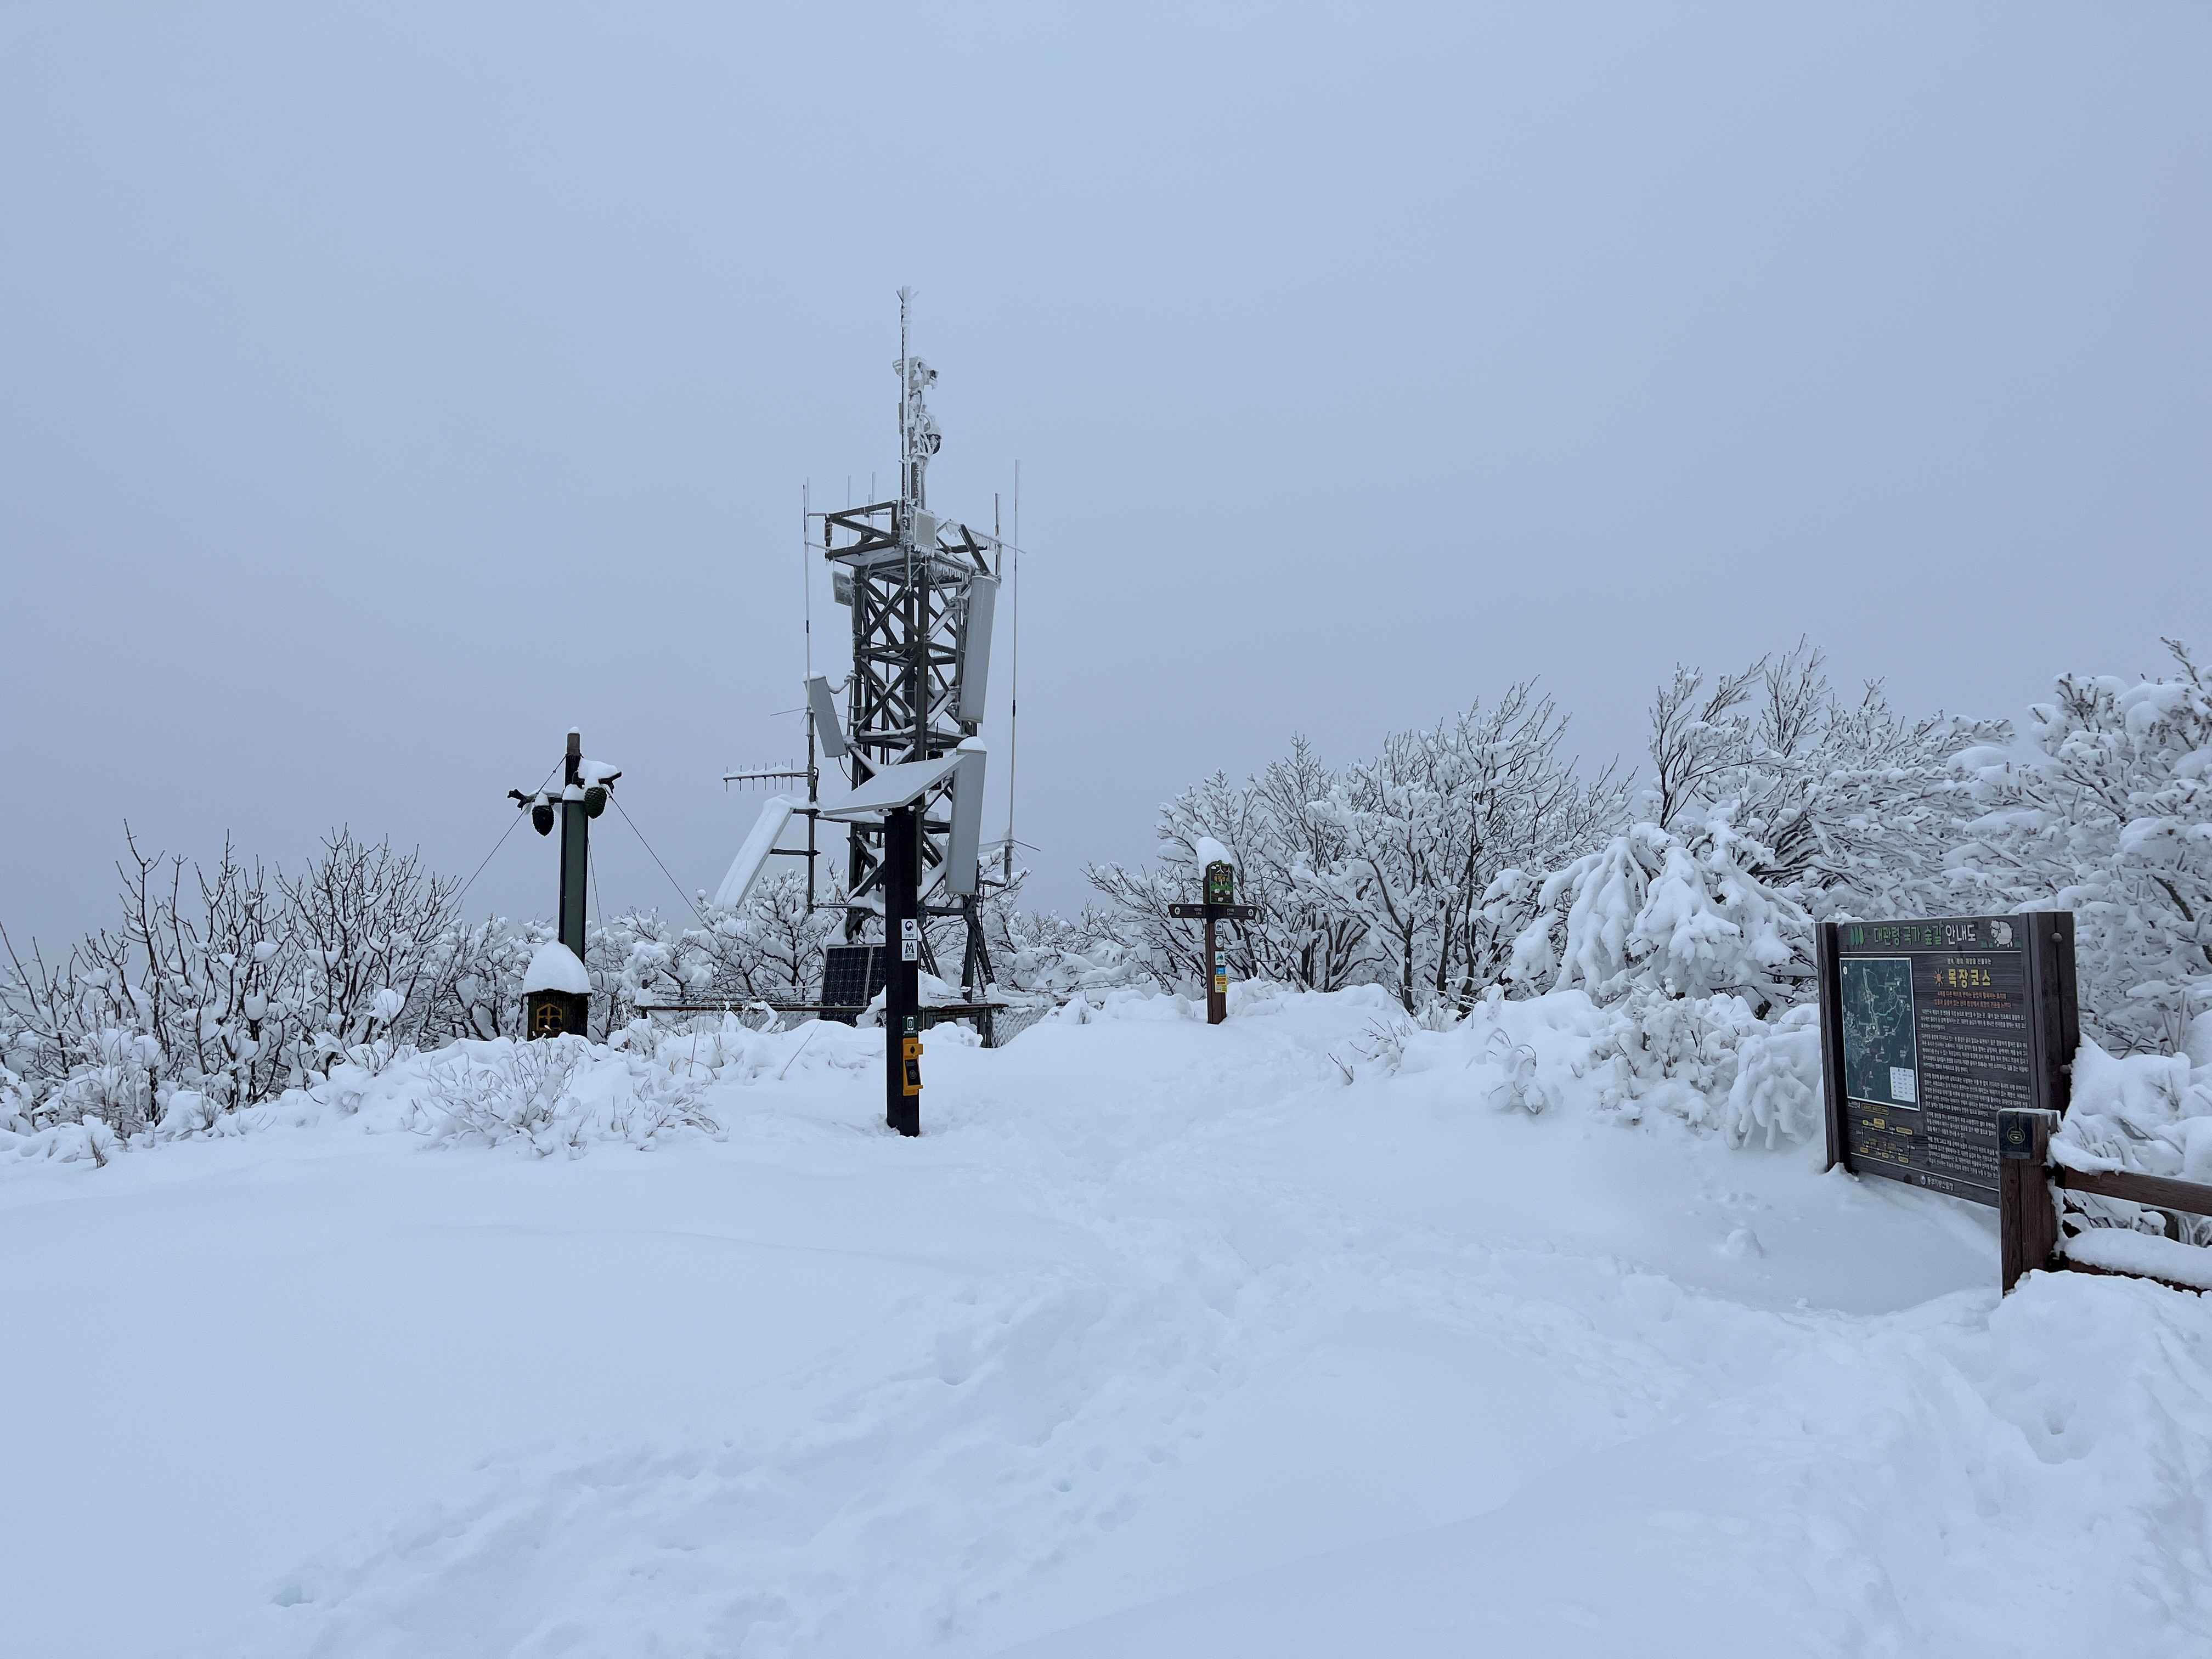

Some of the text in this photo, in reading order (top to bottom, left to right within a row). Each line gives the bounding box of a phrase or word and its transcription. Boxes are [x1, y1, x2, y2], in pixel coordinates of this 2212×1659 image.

[1874, 924, 1976, 946] 대관령 국가 숲길 안내도
[1949, 968, 1991, 988] 목장코스
